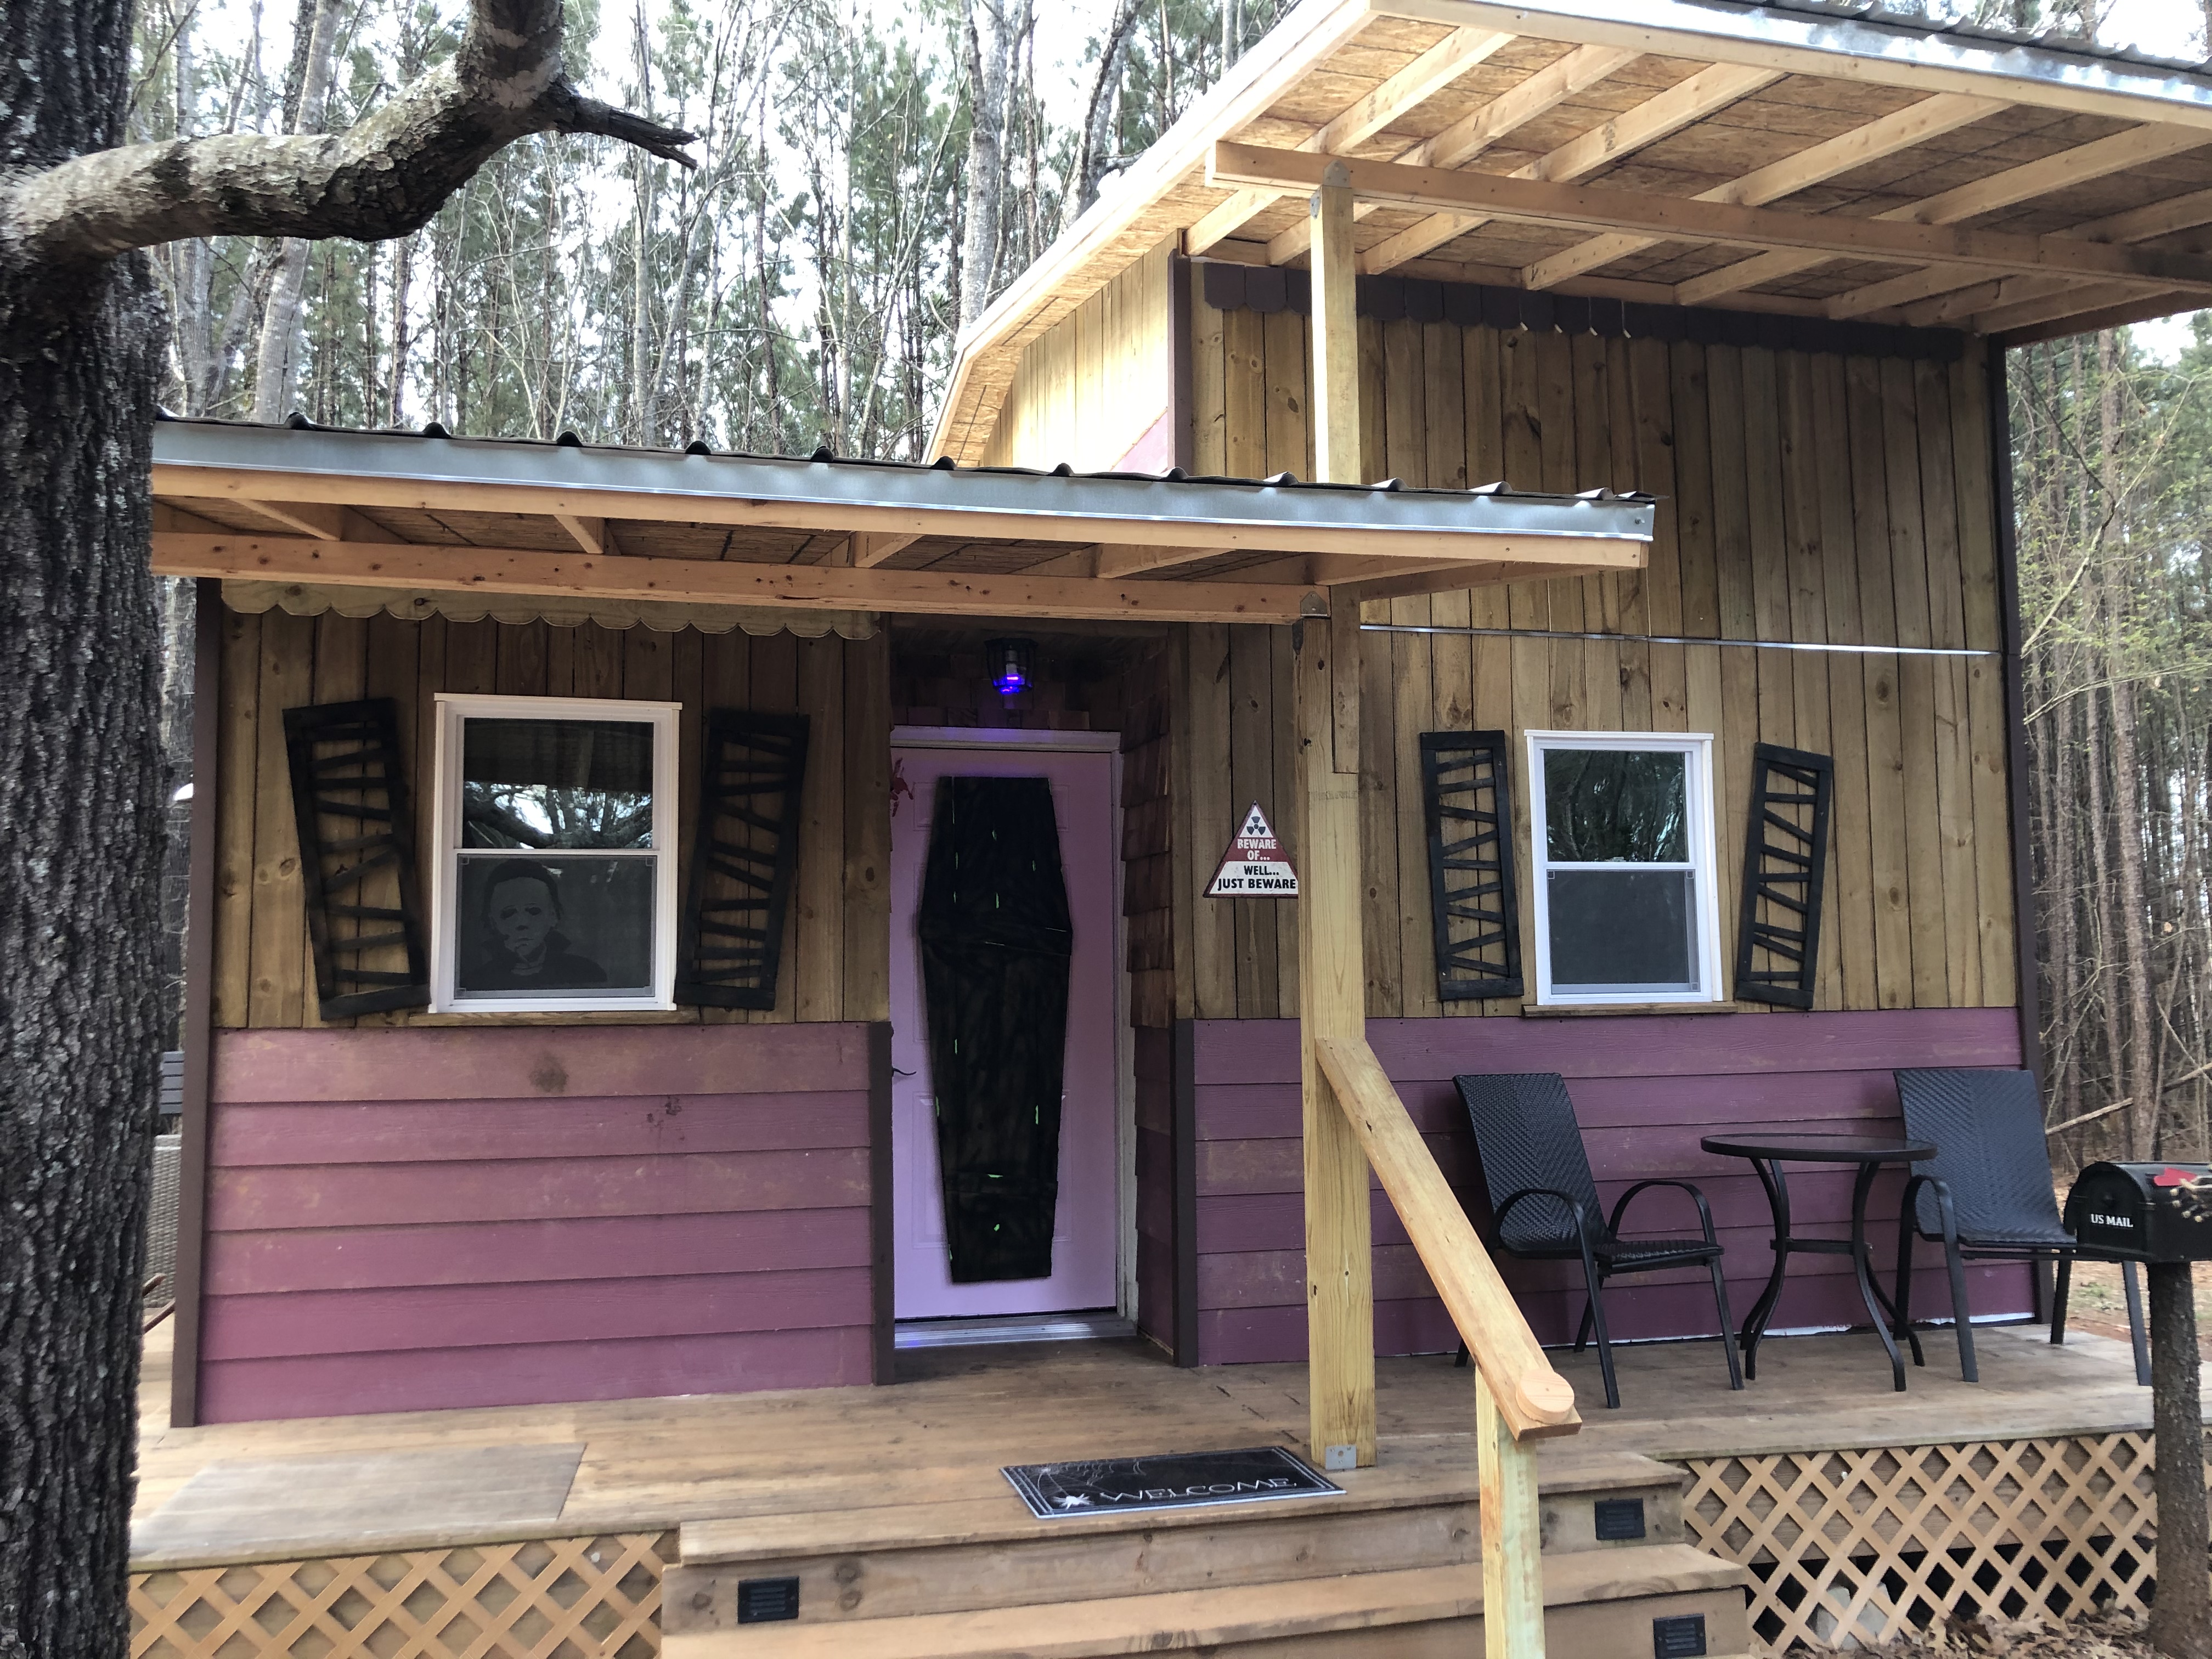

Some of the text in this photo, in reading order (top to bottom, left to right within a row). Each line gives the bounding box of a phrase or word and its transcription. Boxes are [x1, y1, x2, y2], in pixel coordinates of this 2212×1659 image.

[1237, 839, 1277, 849] BEWARE
[1247, 850, 1270, 860] OF...
[1244, 865, 1279, 876] WELL...
[1217, 878, 1296, 891] JUST BEWARE
[2090, 1213, 2134, 1228] US MAIL
[1099, 1478, 1296, 1502] WELCOME
